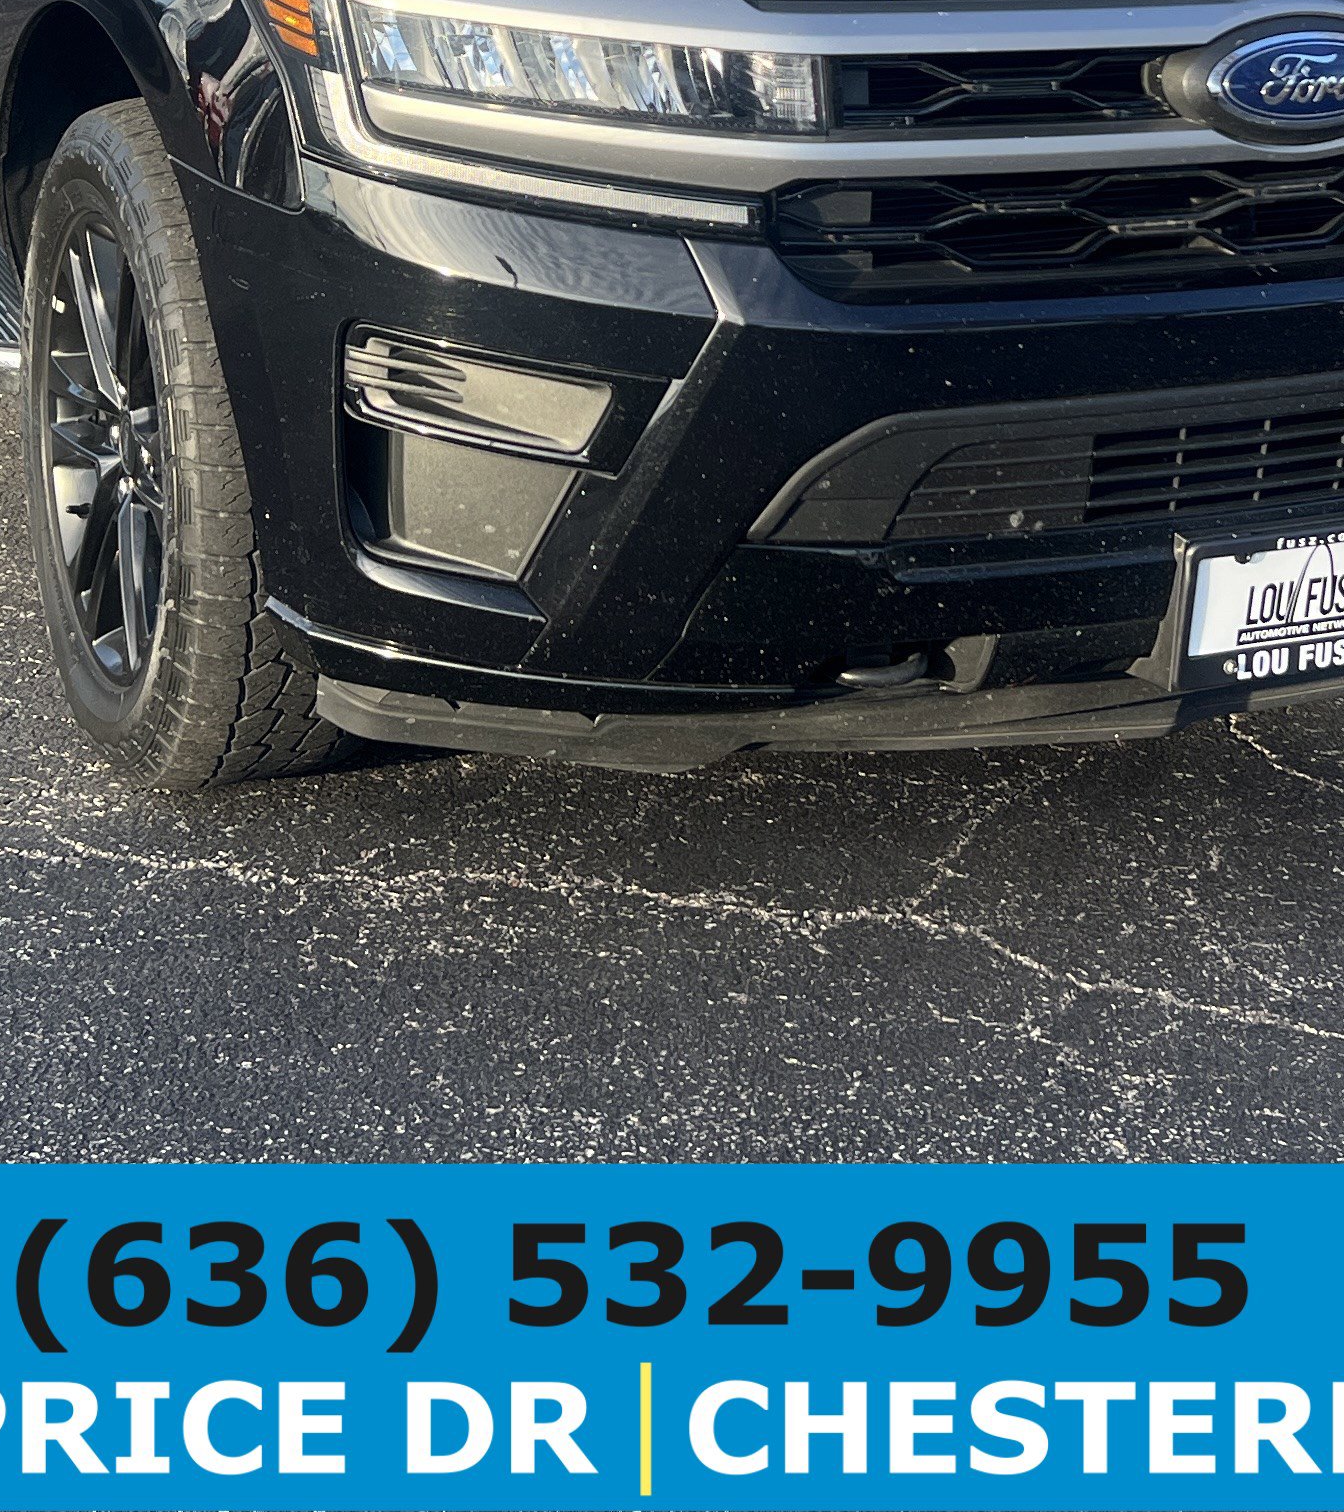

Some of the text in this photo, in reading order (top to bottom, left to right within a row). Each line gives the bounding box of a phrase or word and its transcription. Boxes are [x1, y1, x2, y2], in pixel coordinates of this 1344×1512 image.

[1245, 580, 1295, 626] LOU
[1239, 623, 1311, 643] AUTOMOTIVE
[1236, 646, 1290, 681] LOU
